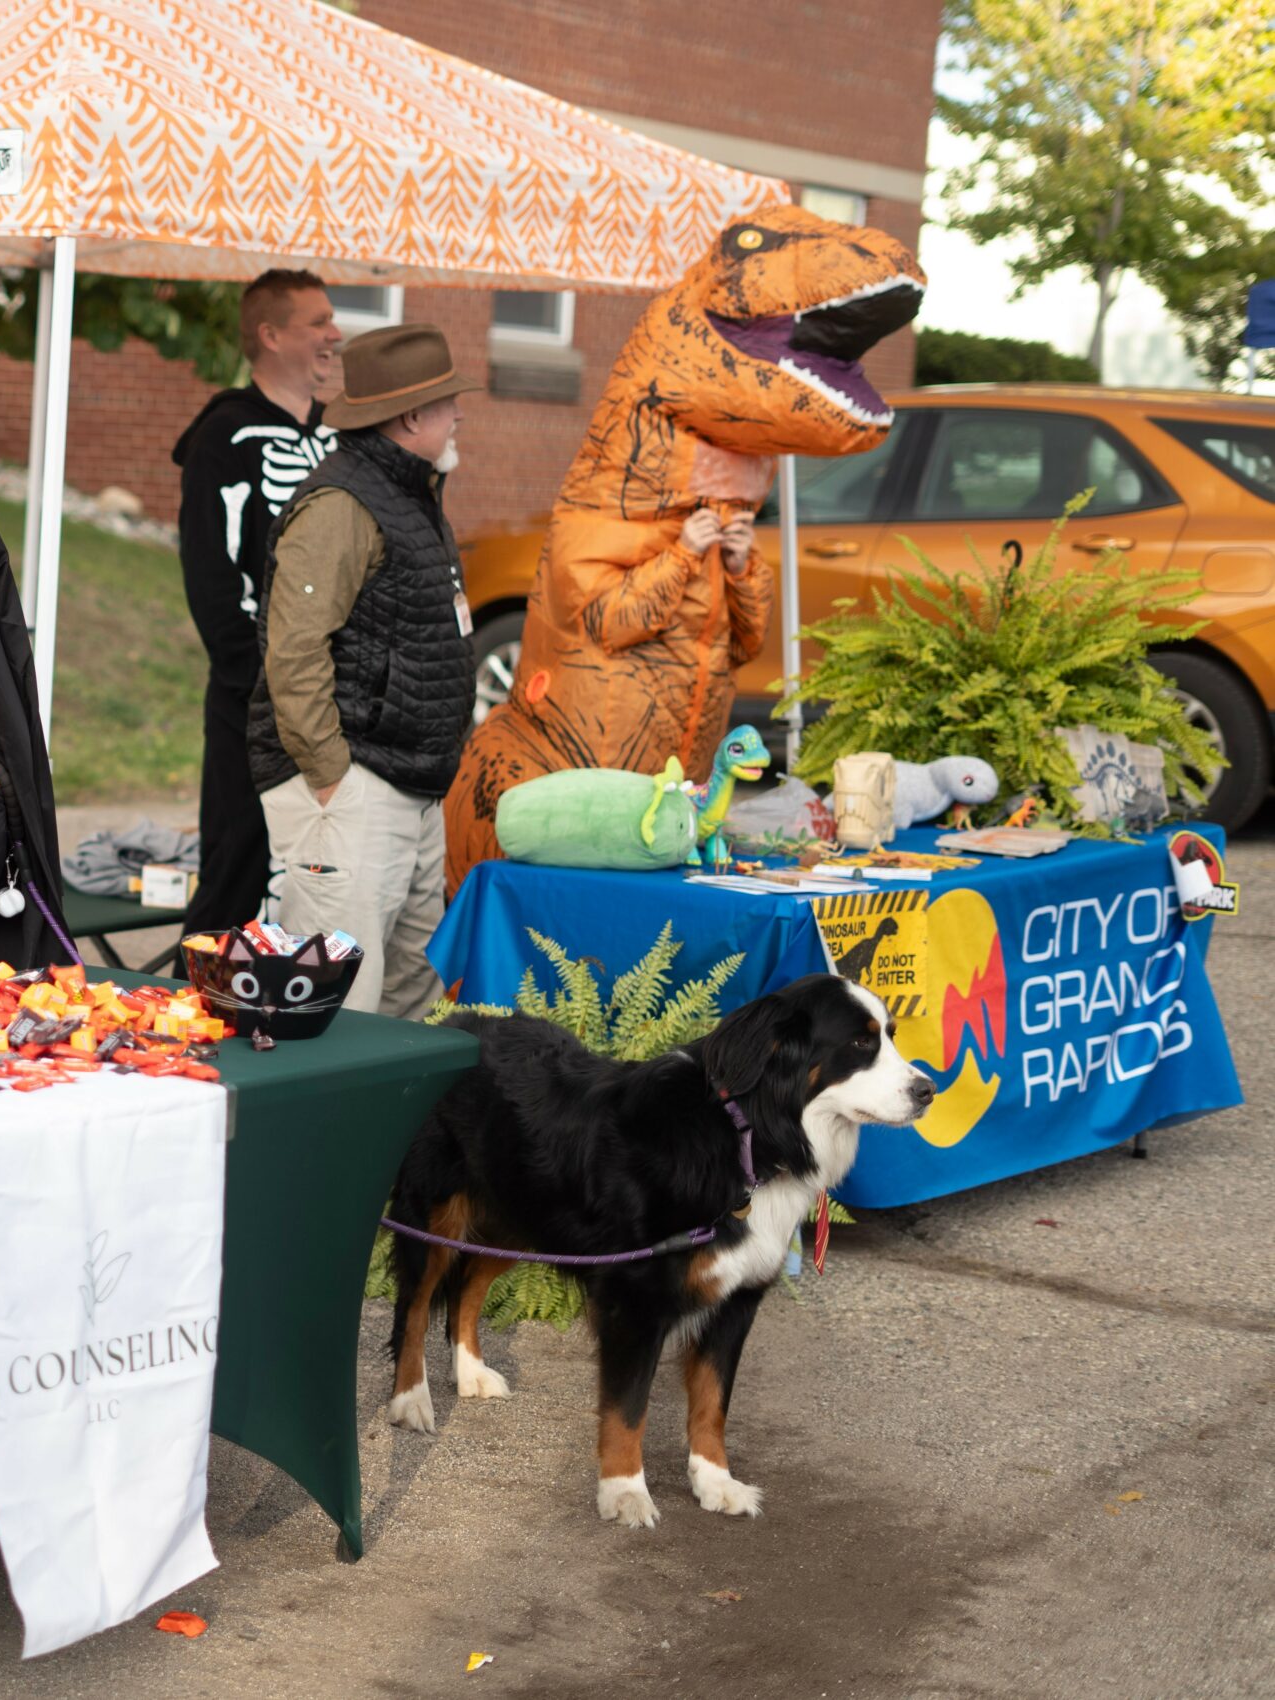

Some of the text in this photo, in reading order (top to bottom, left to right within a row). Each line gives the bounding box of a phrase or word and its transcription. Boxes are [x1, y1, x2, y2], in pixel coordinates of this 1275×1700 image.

[1021, 885, 1180, 964] CITY OF
[877, 970, 916, 987] ENTER
[878, 954, 916, 969] DO NOT
[1020, 940, 1186, 1036] GRAND
[1022, 999, 1193, 1109] RAPIDS
[87, 1398, 122, 1424] LLC
